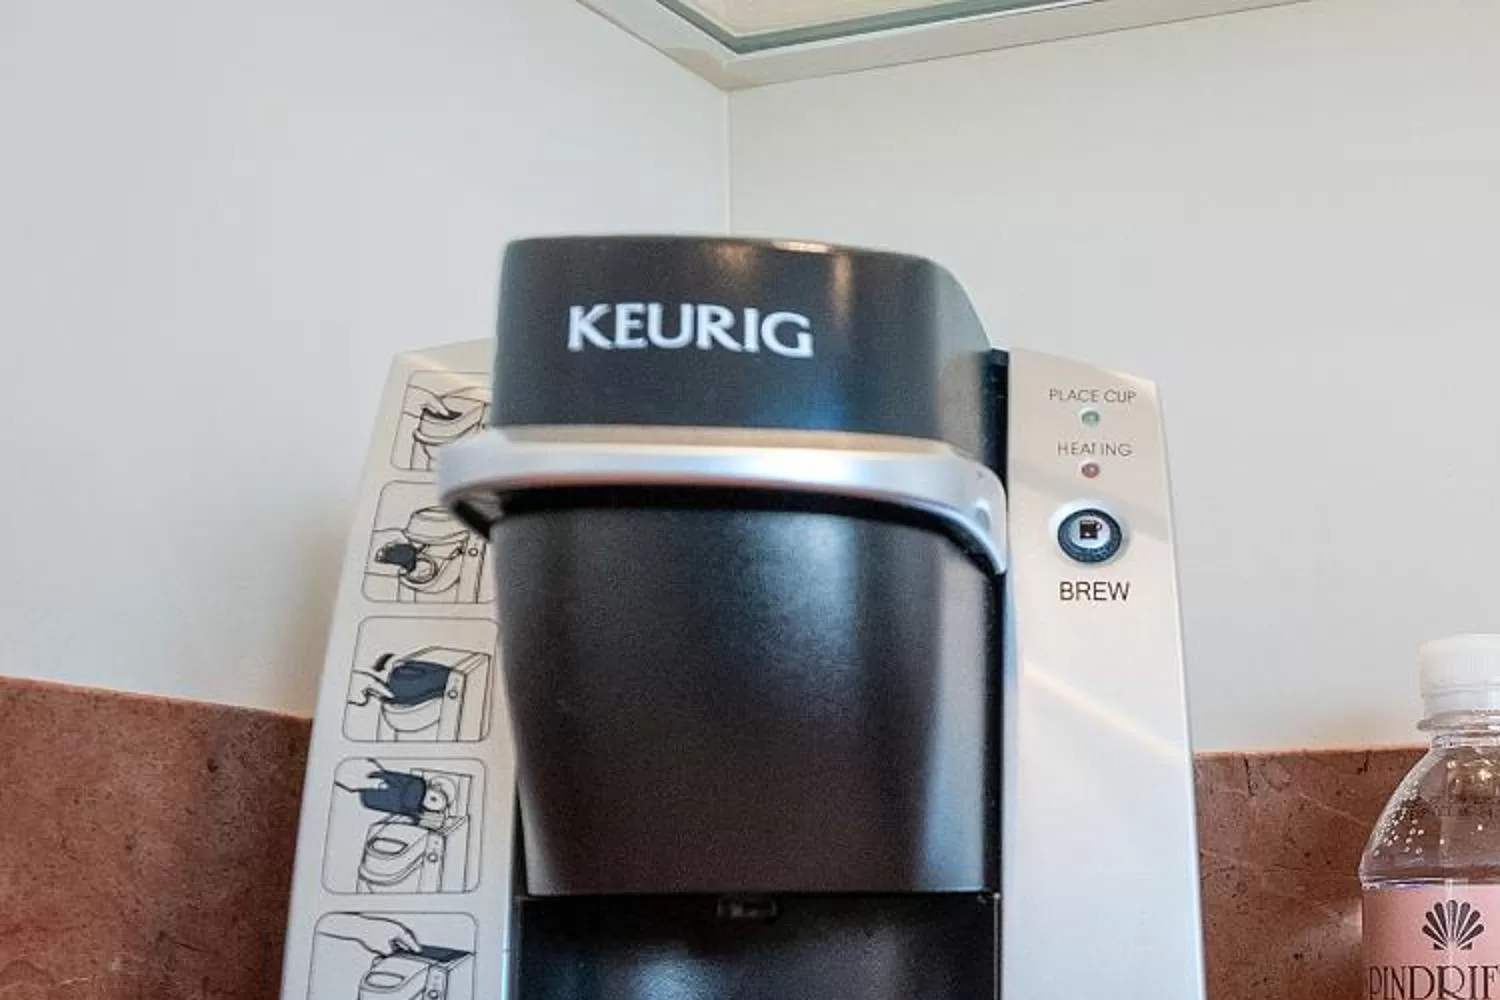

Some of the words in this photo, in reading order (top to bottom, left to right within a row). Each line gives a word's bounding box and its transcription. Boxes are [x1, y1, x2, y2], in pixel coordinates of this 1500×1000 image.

[567, 302, 814, 359] KEURIG
[1048, 388, 1099, 403] PLACE
[1103, 389, 1137, 404] CUP
[1057, 442, 1133, 457] HEATING
[1059, 581, 1130, 601] BREW
